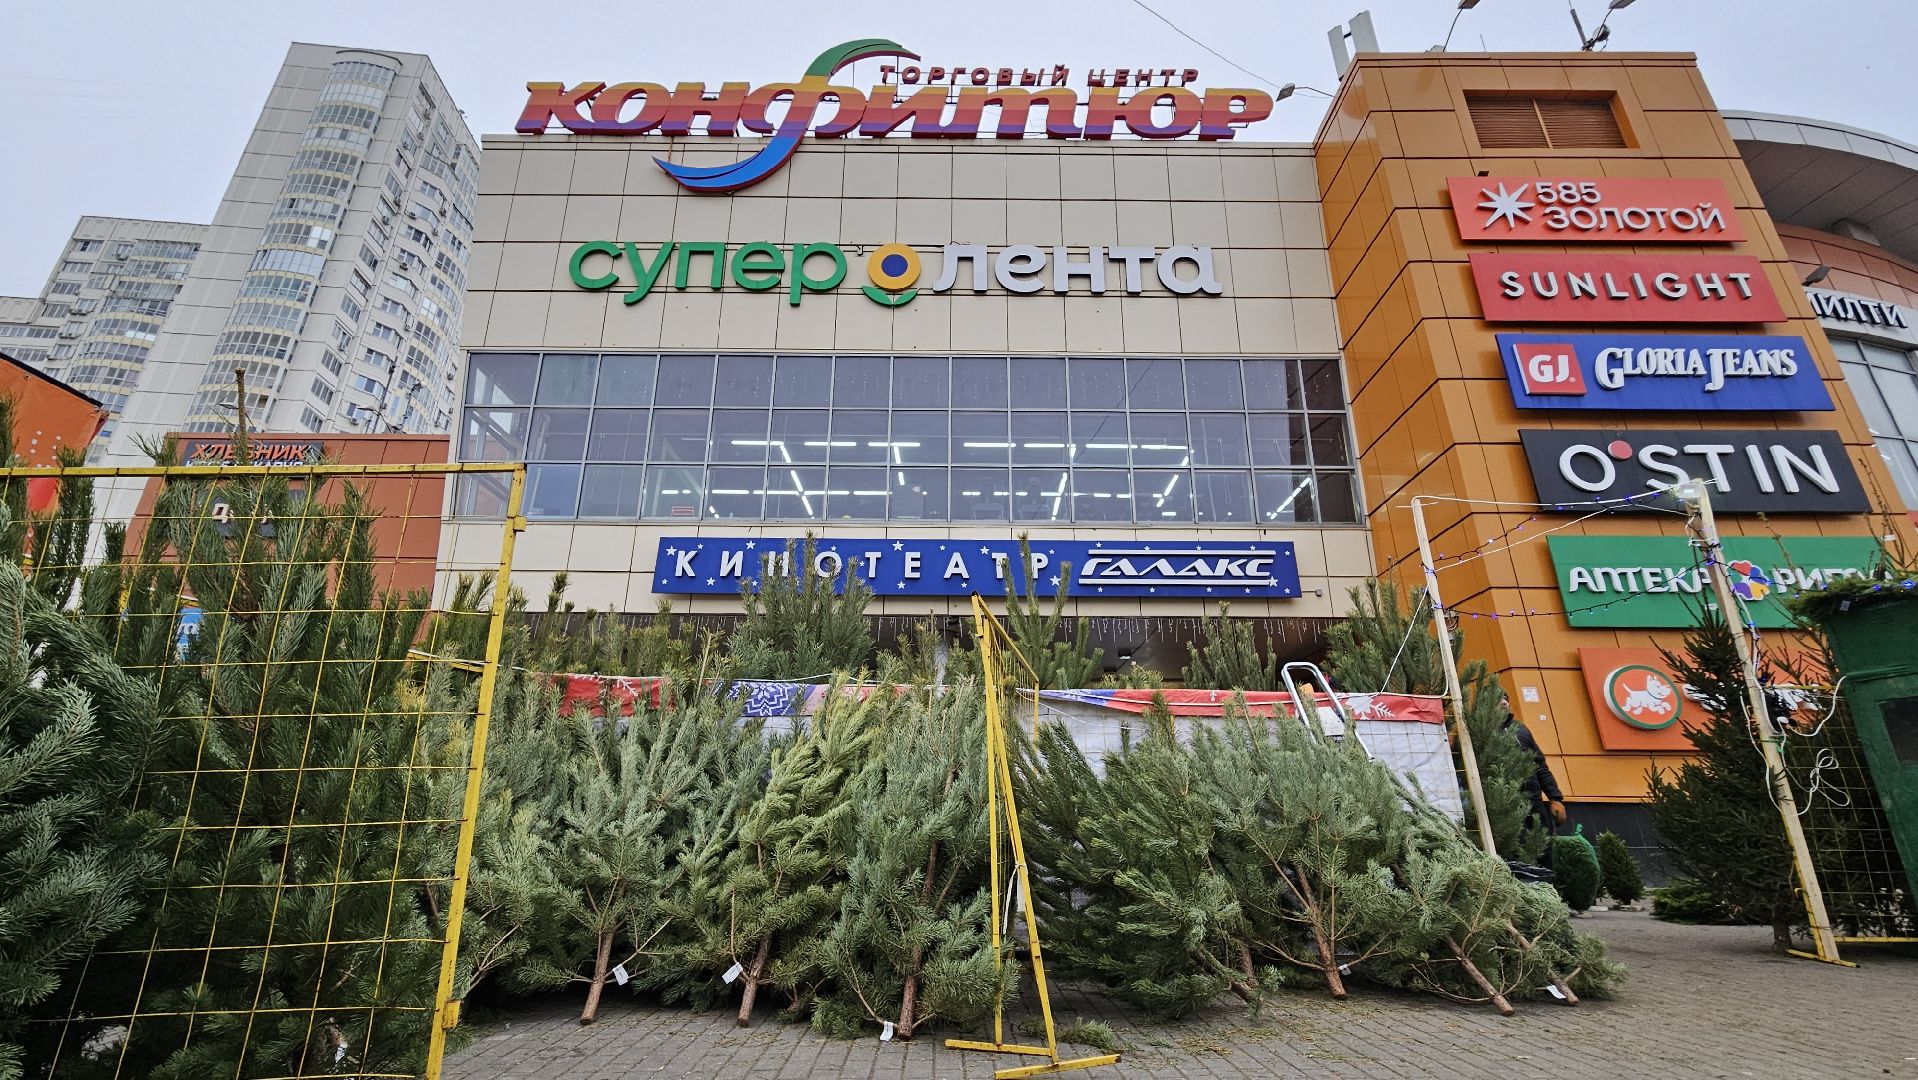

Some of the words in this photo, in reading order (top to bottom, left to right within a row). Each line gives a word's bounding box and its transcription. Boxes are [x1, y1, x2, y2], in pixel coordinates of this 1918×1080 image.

[880, 64, 1070, 86] ТОРГОВЫЙ
[1087, 68, 1199, 87] ЦЕНТР
[1535, 181, 1602, 205] 585
[1544, 202, 1727, 232] ЗОЛОТОЙ
[567, 239, 848, 306] супер
[932, 242, 1223, 295] лента
[1500, 270, 1753, 299] SUNLIGHT
[674, 550, 1049, 580] КИНОТЕАТР
[1080, 557, 1274, 577] ГАЛАКС
